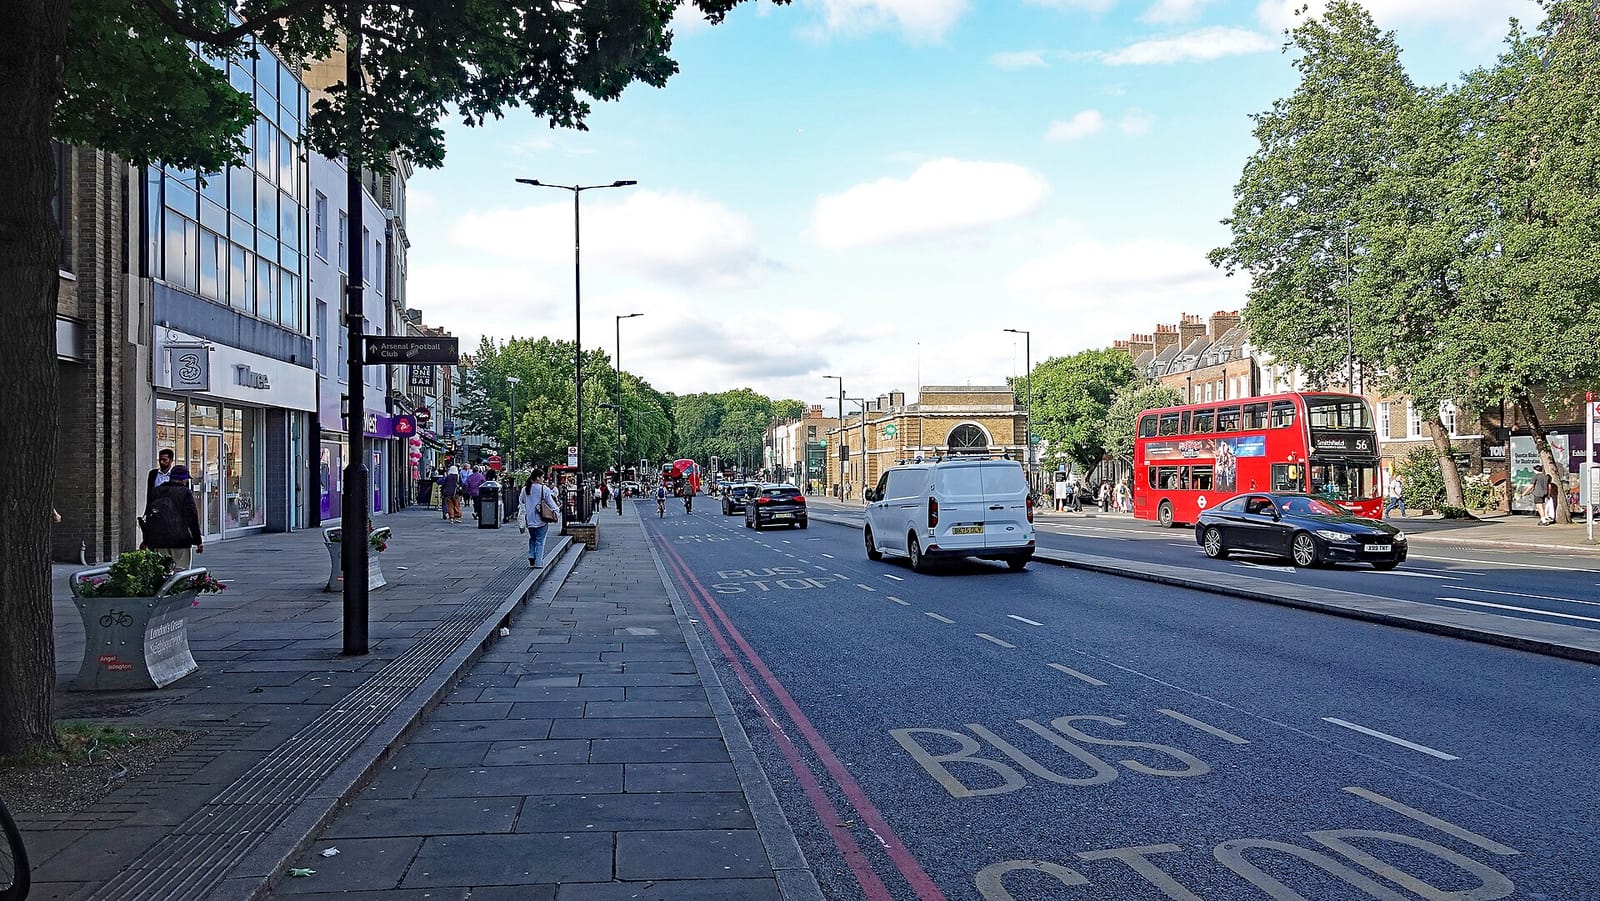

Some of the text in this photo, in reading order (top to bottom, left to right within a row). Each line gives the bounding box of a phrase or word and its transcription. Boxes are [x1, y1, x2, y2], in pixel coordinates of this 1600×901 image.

[178, 353, 202, 380] 3
[1355, 440, 1367, 450] 56
[717, 566, 805, 579] BUS
[711, 577, 837, 594] STOP
[888, 715, 1211, 800] BUS
